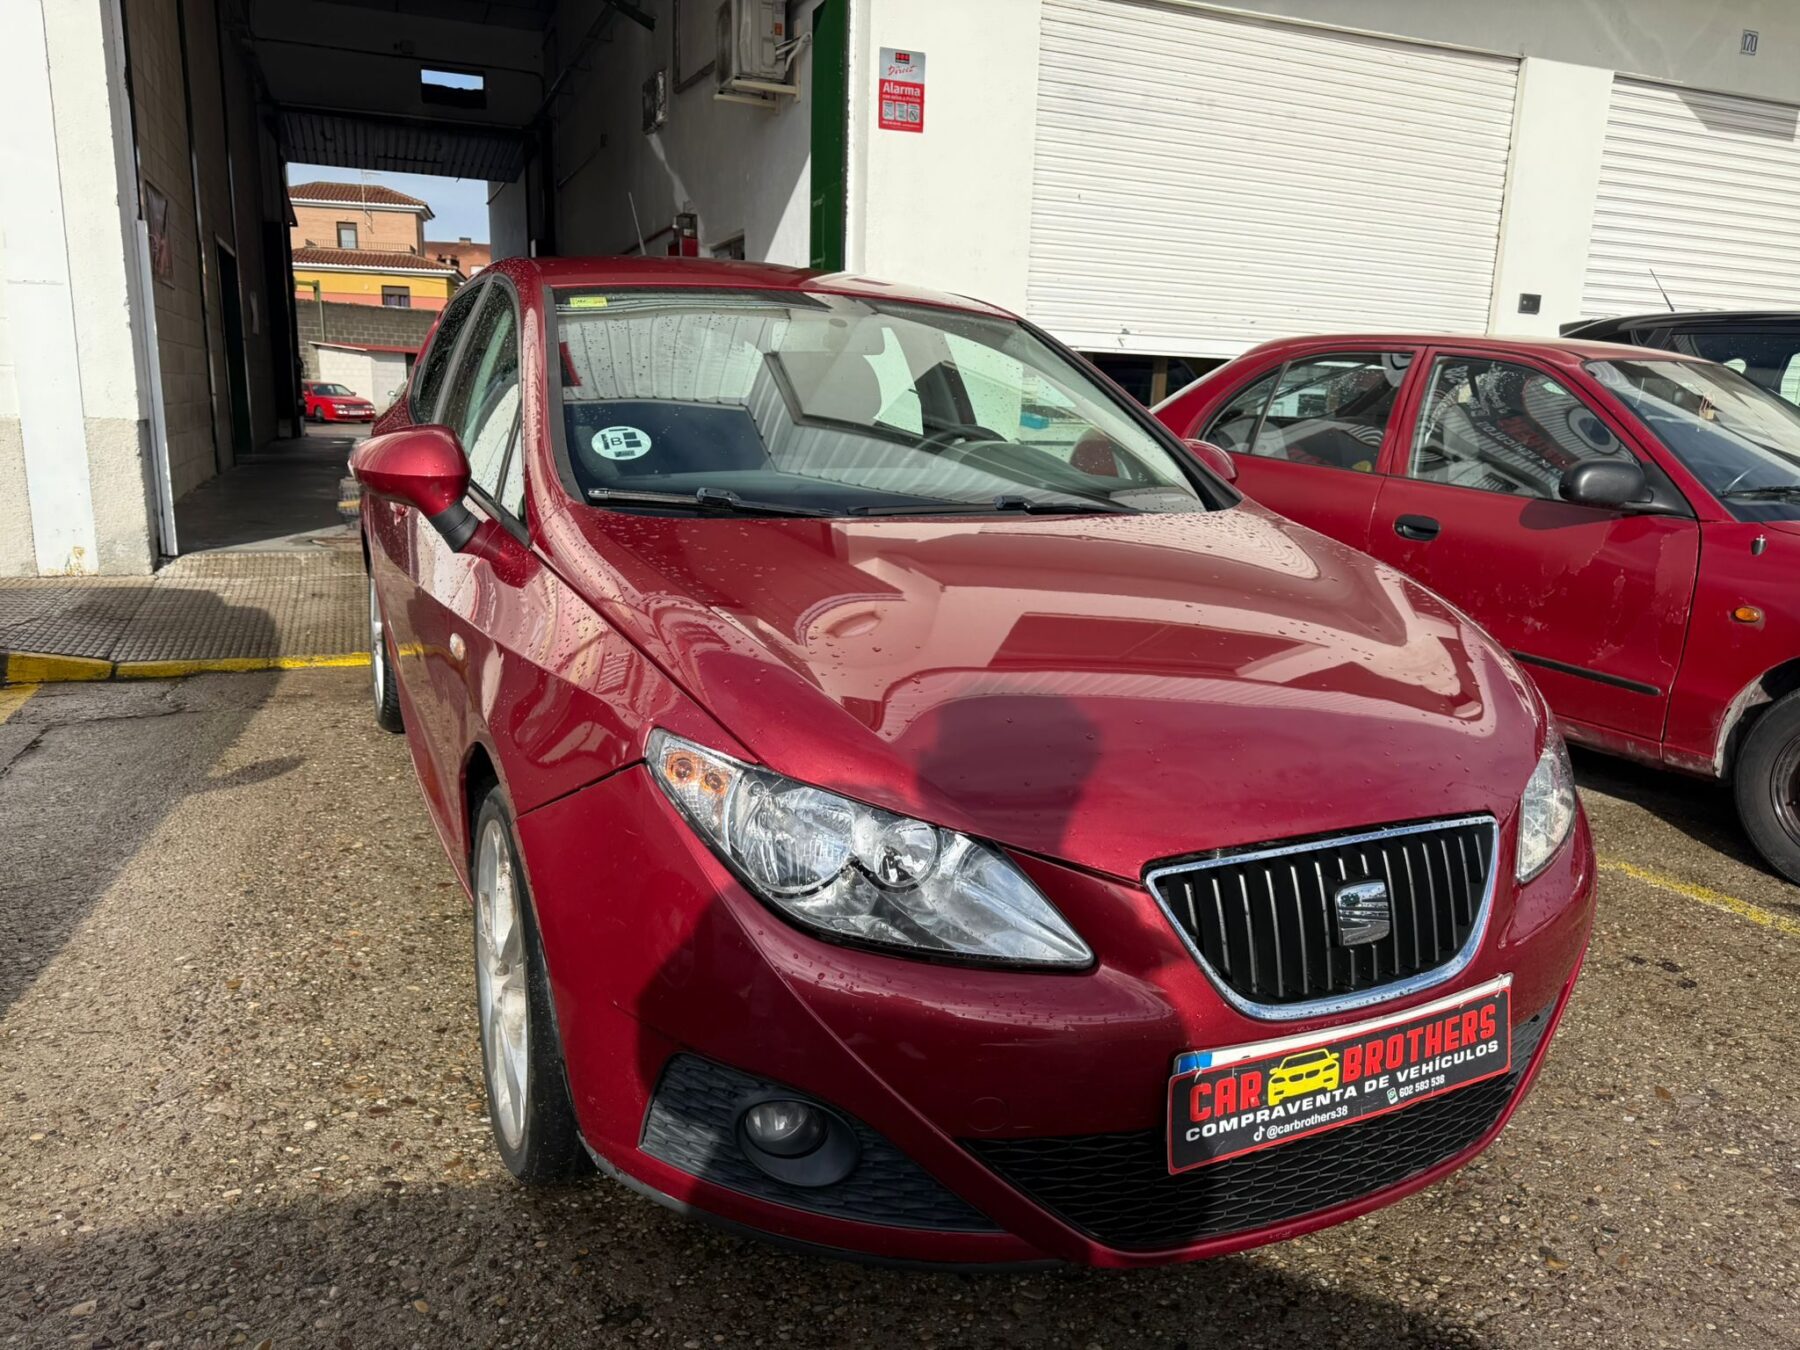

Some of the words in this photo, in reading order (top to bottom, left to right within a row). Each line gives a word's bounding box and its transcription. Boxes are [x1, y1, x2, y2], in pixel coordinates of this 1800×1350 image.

[883, 82, 920, 97] Alarma
[610, 437, 622, 446] B
[1190, 1071, 1263, 1123] CAR
[1342, 1003, 1496, 1083] BROTHERS
[1185, 1086, 1358, 1142] COMPRAVENTA
[1364, 1075, 1390, 1093] DE
[1396, 1040, 1499, 1083] VEHÍCULOS
[1399, 1085, 1414, 1098] 602
[1415, 1079, 1430, 1093] 583
[1431, 1074, 1446, 1088] 538
[1266, 1105, 1348, 1140] @carbrothers38
